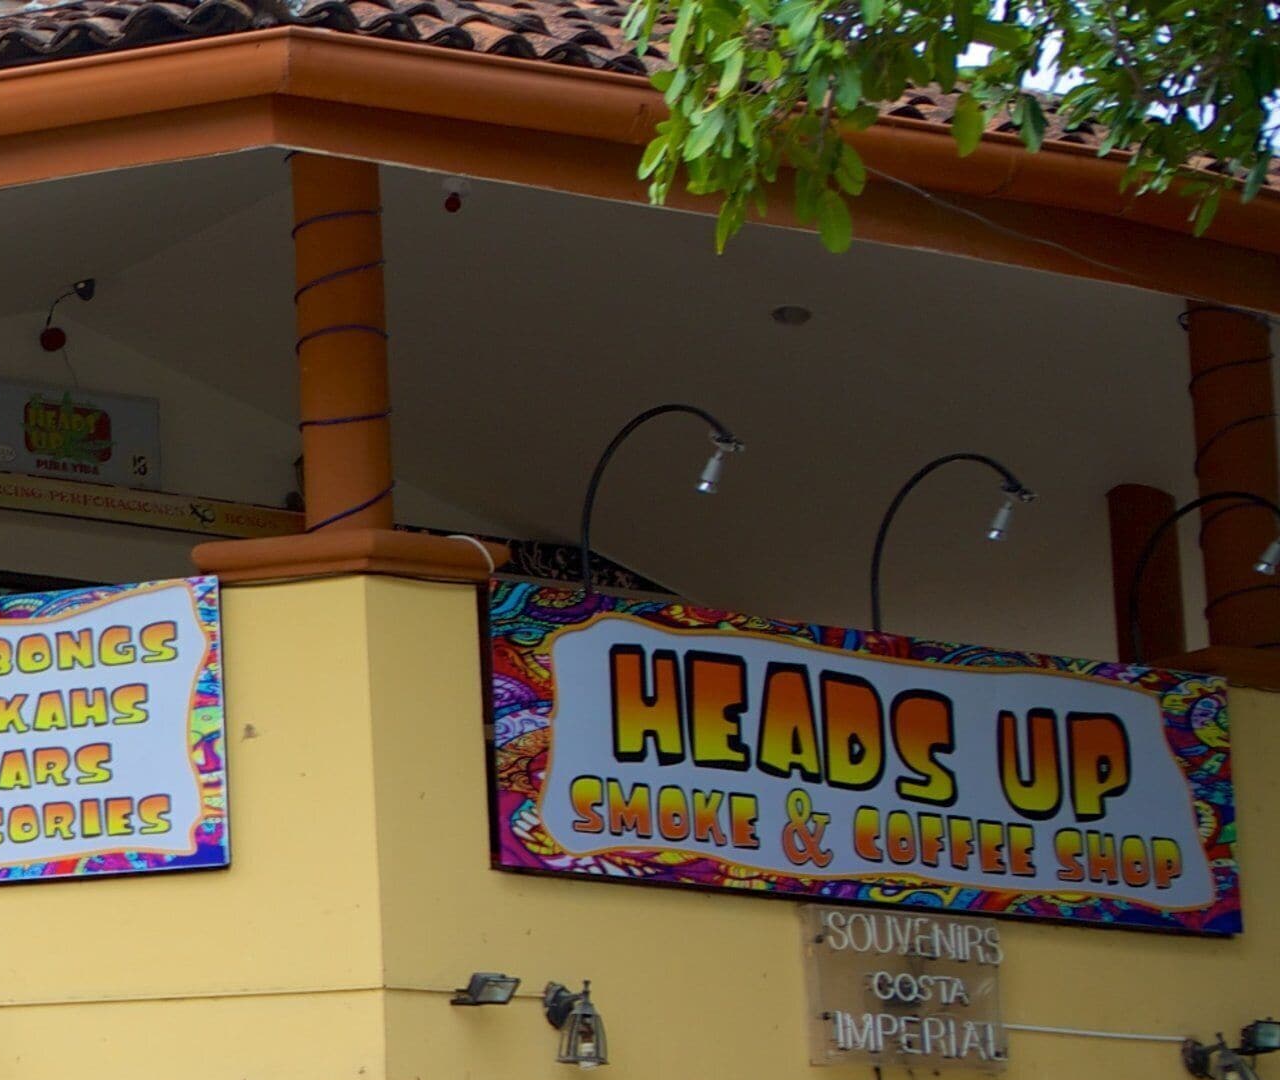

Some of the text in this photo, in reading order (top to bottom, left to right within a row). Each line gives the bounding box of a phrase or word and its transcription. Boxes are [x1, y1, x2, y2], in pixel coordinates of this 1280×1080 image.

[609, 643, 1130, 822] HEADS UP
[570, 775, 1182, 889] SMOKE & COFFEE SHOP
[827, 911, 1004, 965] SOUVENIRS
[873, 971, 970, 1007] COSTA
[834, 1010, 1009, 1061] IMPERIAL
